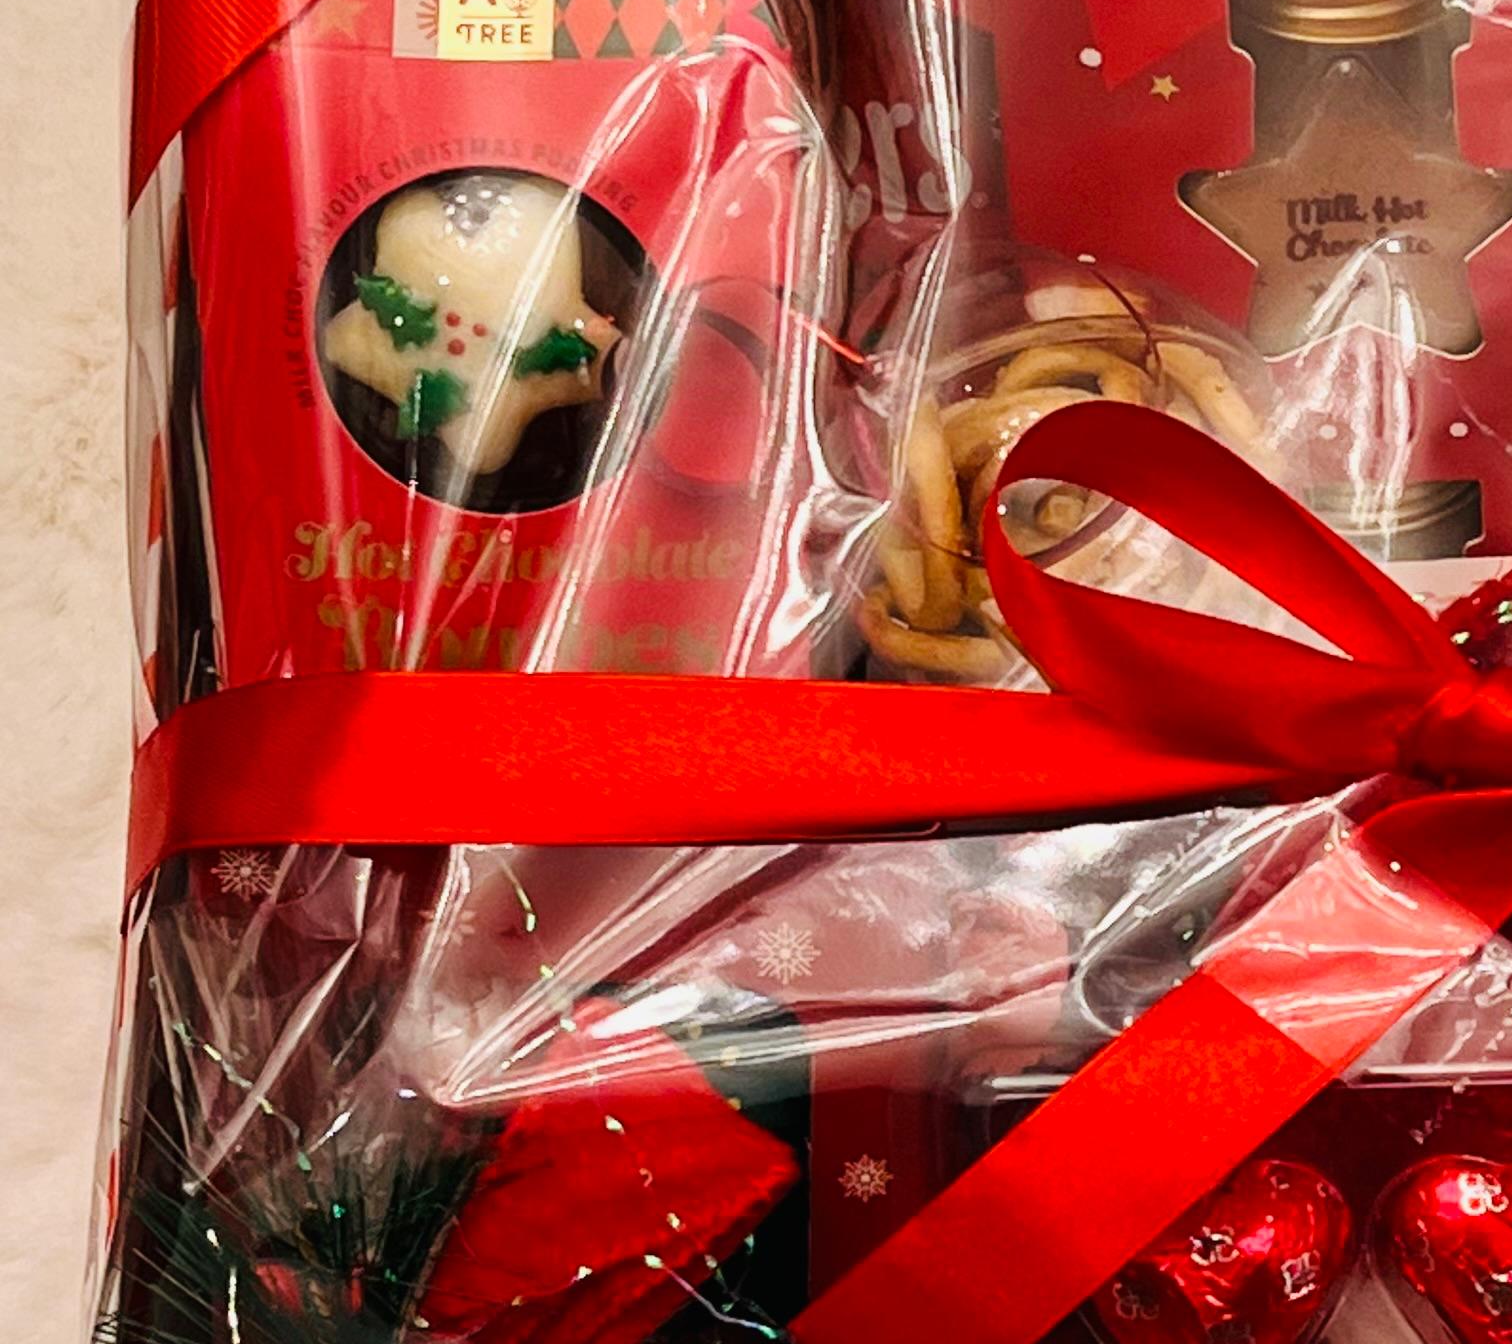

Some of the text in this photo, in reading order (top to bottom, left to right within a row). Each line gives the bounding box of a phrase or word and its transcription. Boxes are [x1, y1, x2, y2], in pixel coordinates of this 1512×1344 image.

[456, 23, 535, 45] TREE
[529, 141, 643, 213] PUDNG
[1372, 196, 1428, 224] Hot
[1286, 226, 1435, 262] Chocte
[432, 523, 746, 588] Choolate
